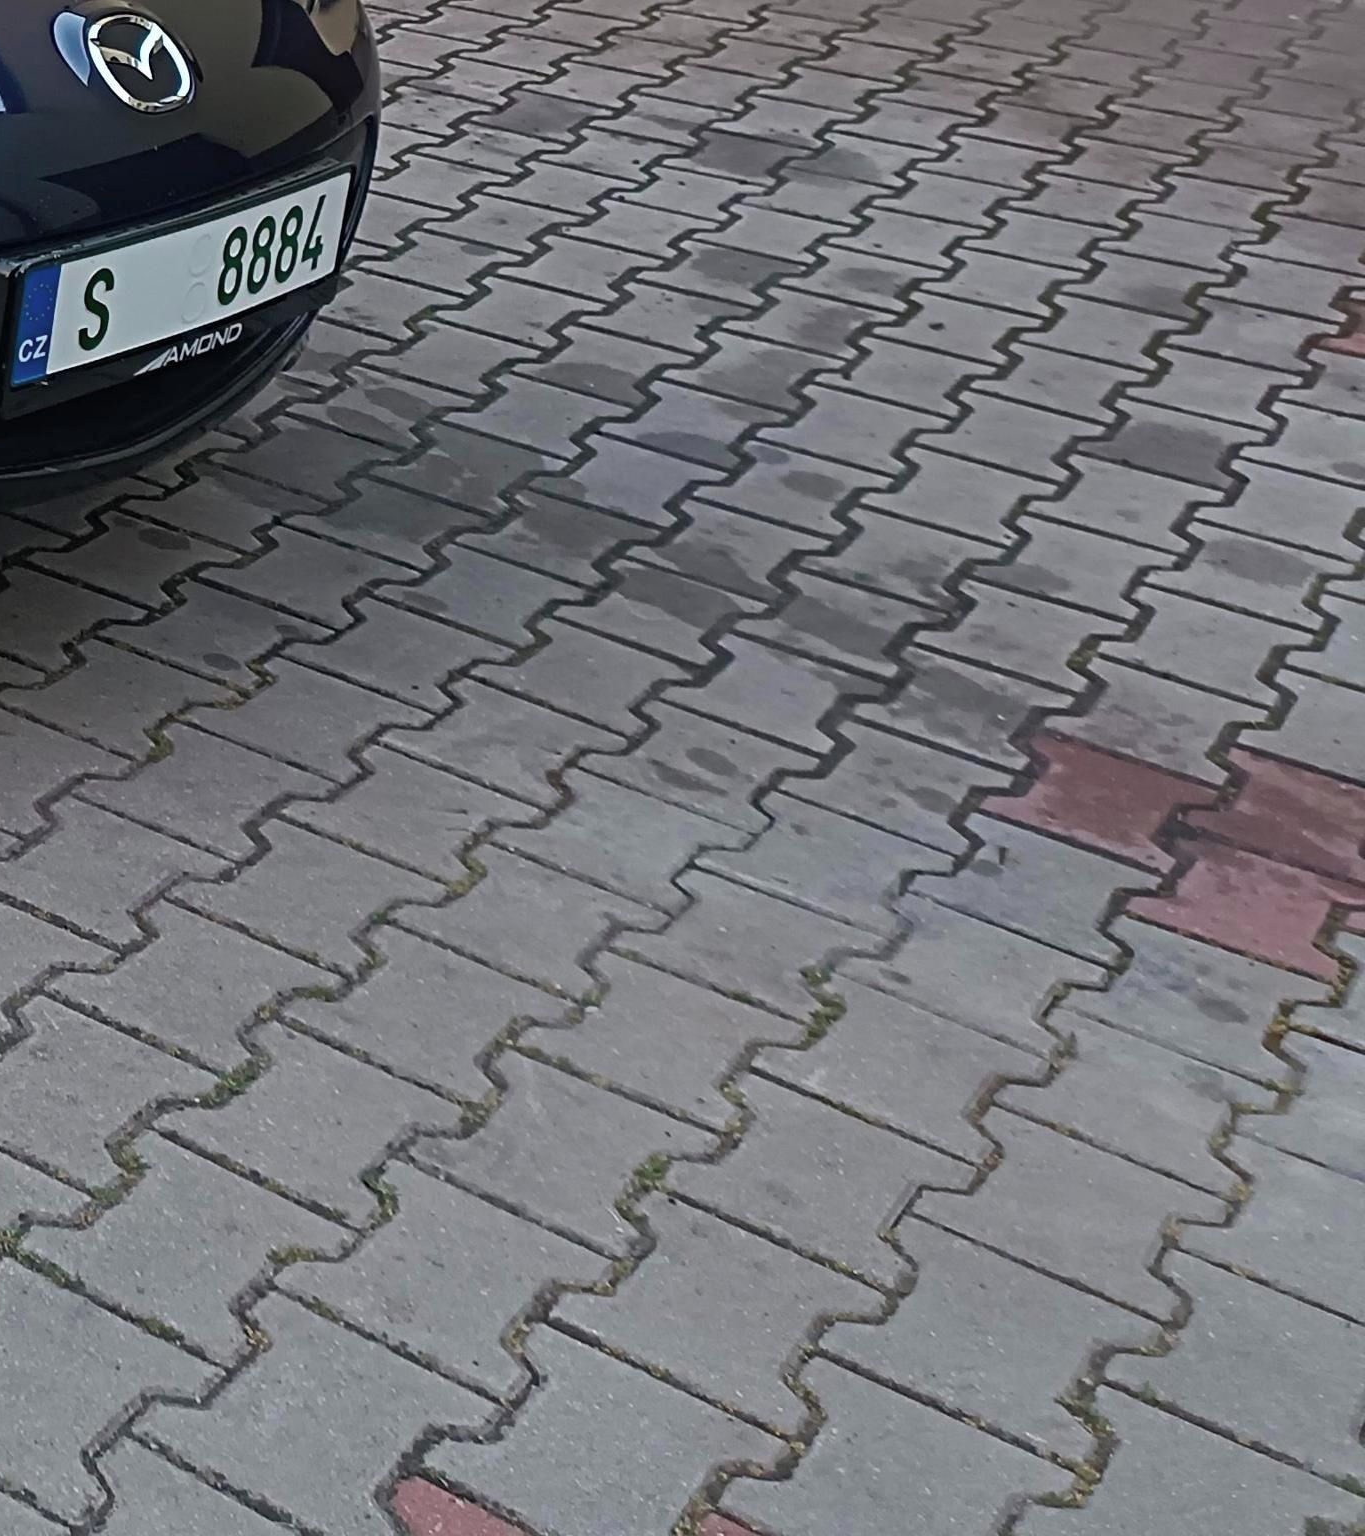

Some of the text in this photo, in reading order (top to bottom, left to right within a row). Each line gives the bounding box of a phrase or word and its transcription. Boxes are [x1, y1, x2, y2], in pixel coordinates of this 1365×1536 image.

[77, 194, 327, 352] S 8884
[18, 334, 49, 363] CZ
